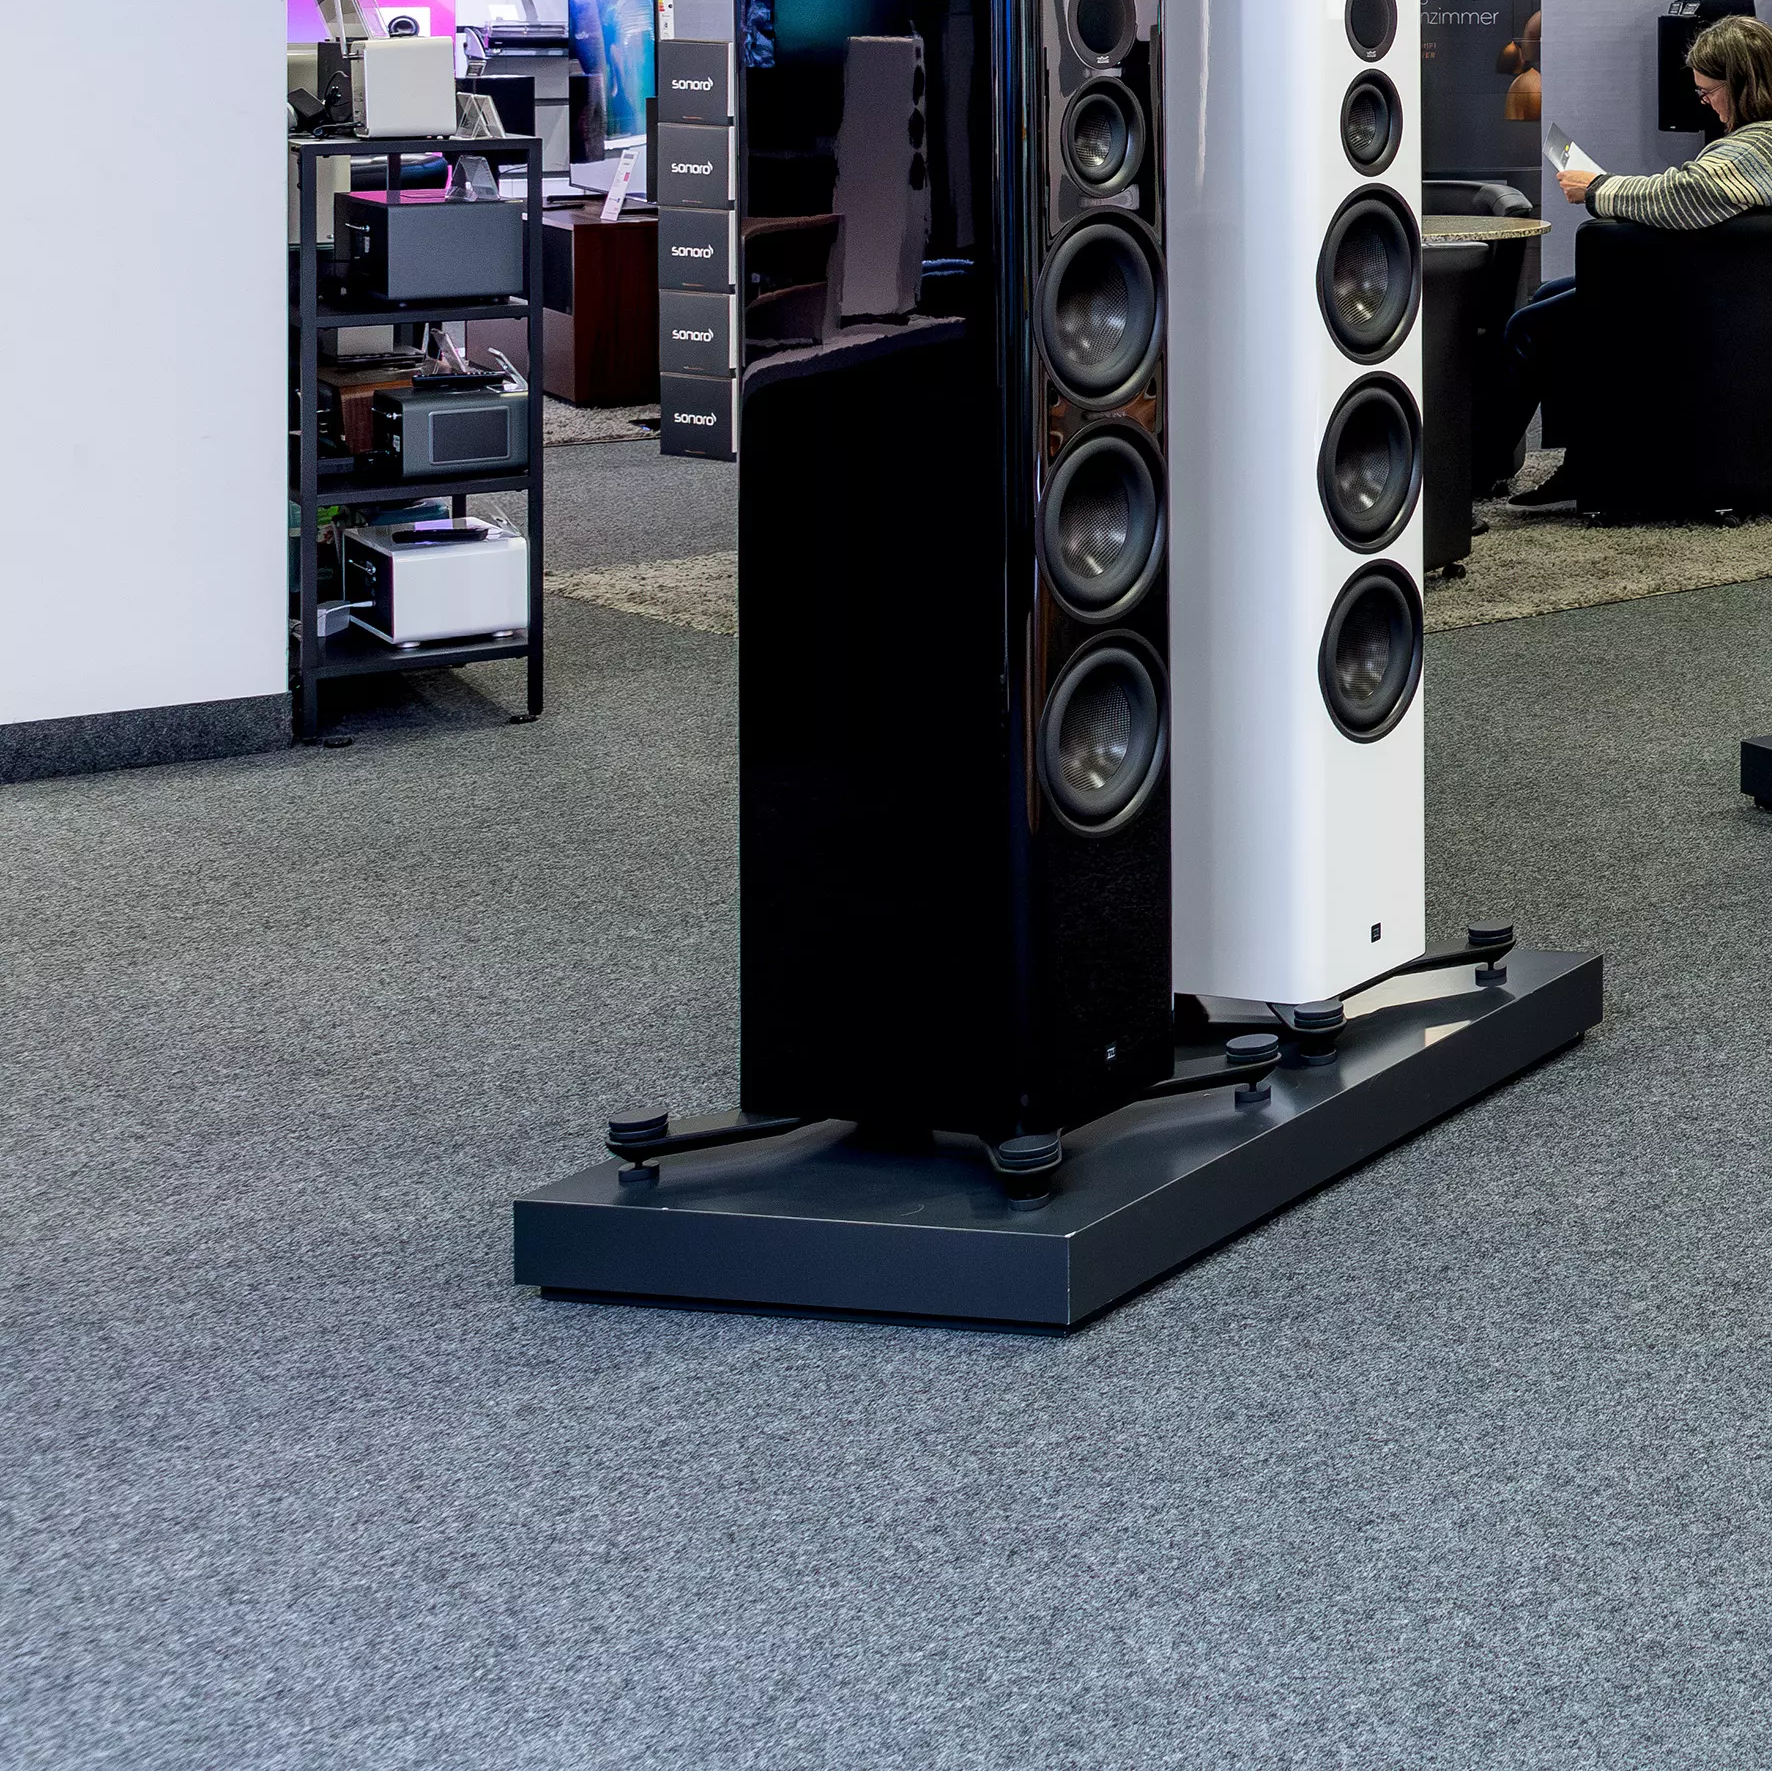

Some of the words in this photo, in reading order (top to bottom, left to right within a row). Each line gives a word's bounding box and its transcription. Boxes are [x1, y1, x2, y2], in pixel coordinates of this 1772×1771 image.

[1420, 7, 1500, 25] nzimmer
[671, 77, 713, 91] sonoro
[671, 161, 713, 175] sonoro
[671, 245, 714, 258] sonoro
[672, 329, 714, 342] sonoro
[674, 412, 717, 426] sonoro
